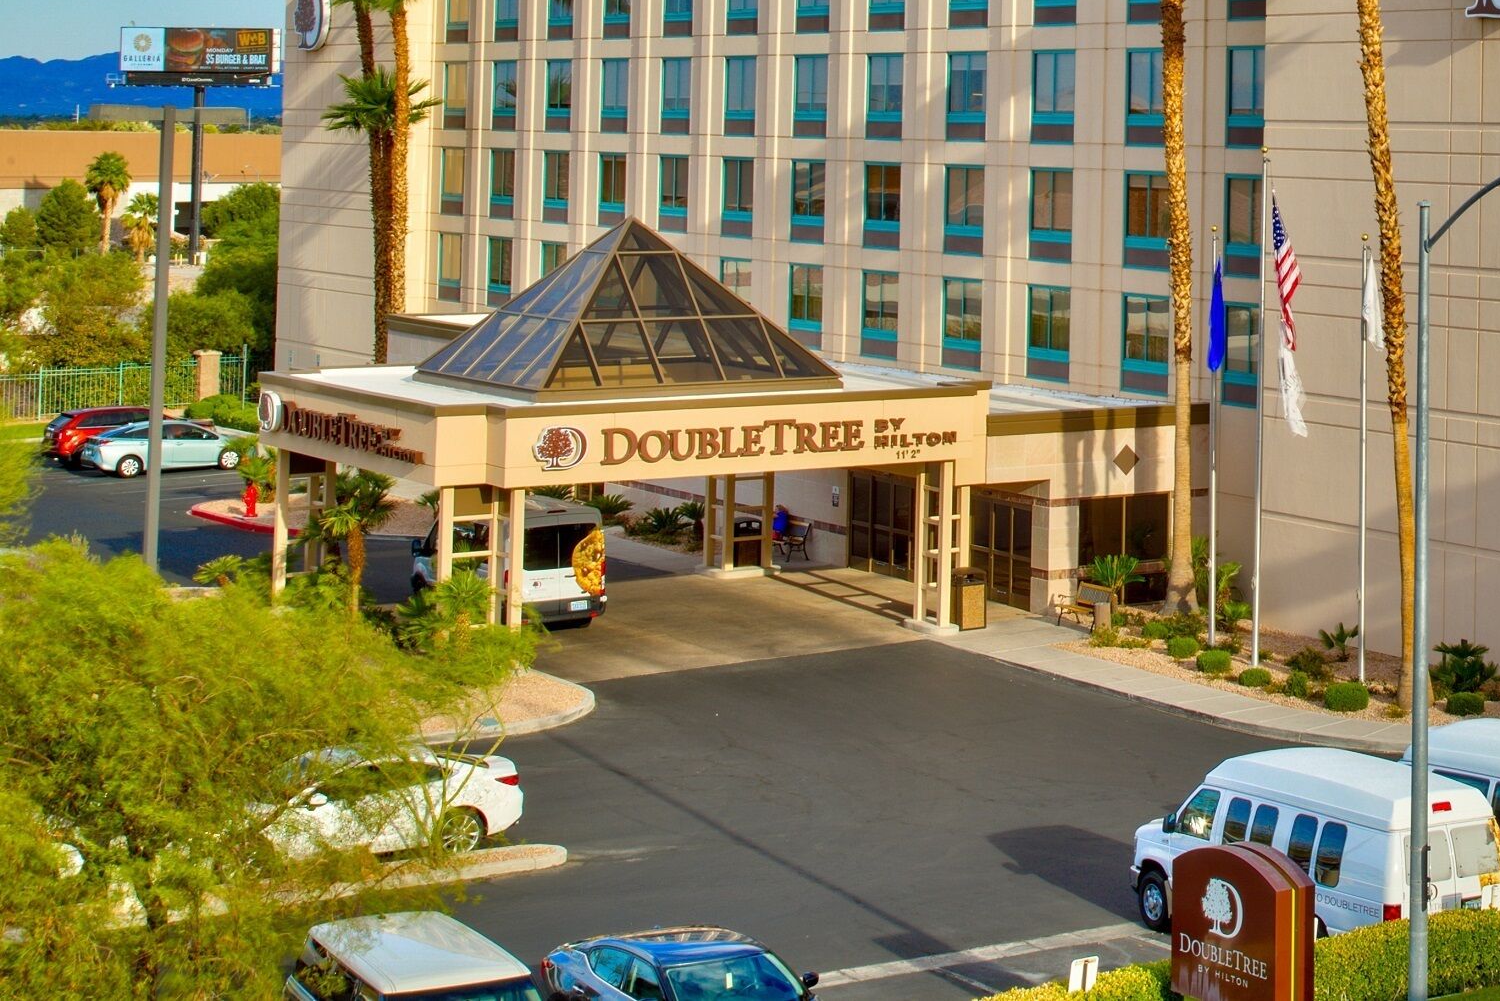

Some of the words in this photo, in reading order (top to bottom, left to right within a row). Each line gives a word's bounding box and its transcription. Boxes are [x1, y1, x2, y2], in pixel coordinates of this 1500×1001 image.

[123, 54, 161, 63] GALLERIA
[205, 53, 215, 65] $5
[215, 53, 241, 65] BURGER
[249, 54, 267, 65] BRAT
[282, 400, 381, 453] DOUBLETREE
[599, 418, 866, 466] DOUBLETREE
[873, 417, 906, 434] BY
[873, 430, 958, 450] HILTON
[1324, 894, 1380, 918] DOUBLETREE
[1179, 932, 1268, 980] DOUBLETREE
[1197, 963, 1210, 974] BY
[1214, 970, 1249, 988] HILTON
